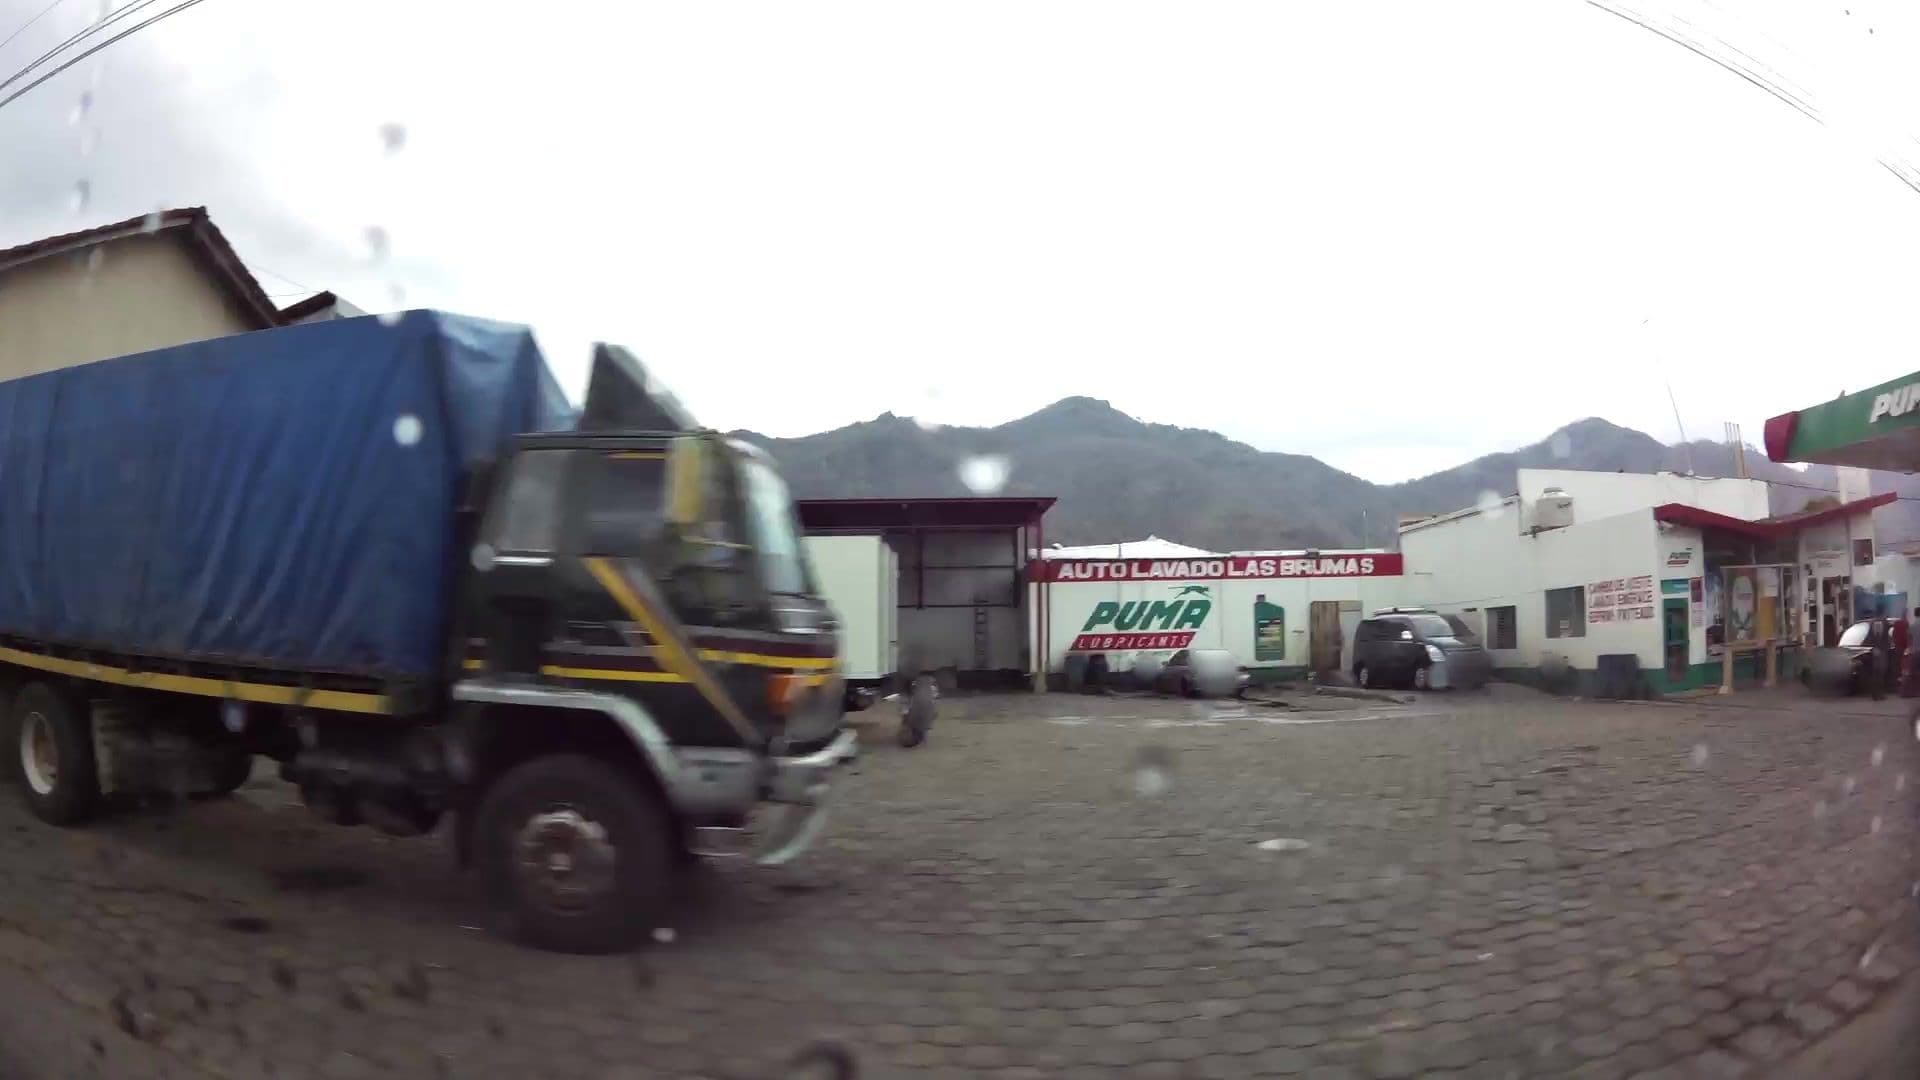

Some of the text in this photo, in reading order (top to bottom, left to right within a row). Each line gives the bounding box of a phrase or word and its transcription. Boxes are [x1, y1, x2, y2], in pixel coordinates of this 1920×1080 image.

[1057, 557, 1375, 579] AUTO LAVADO LAS BRUMAS
[1081, 599, 1212, 632] PUMA
